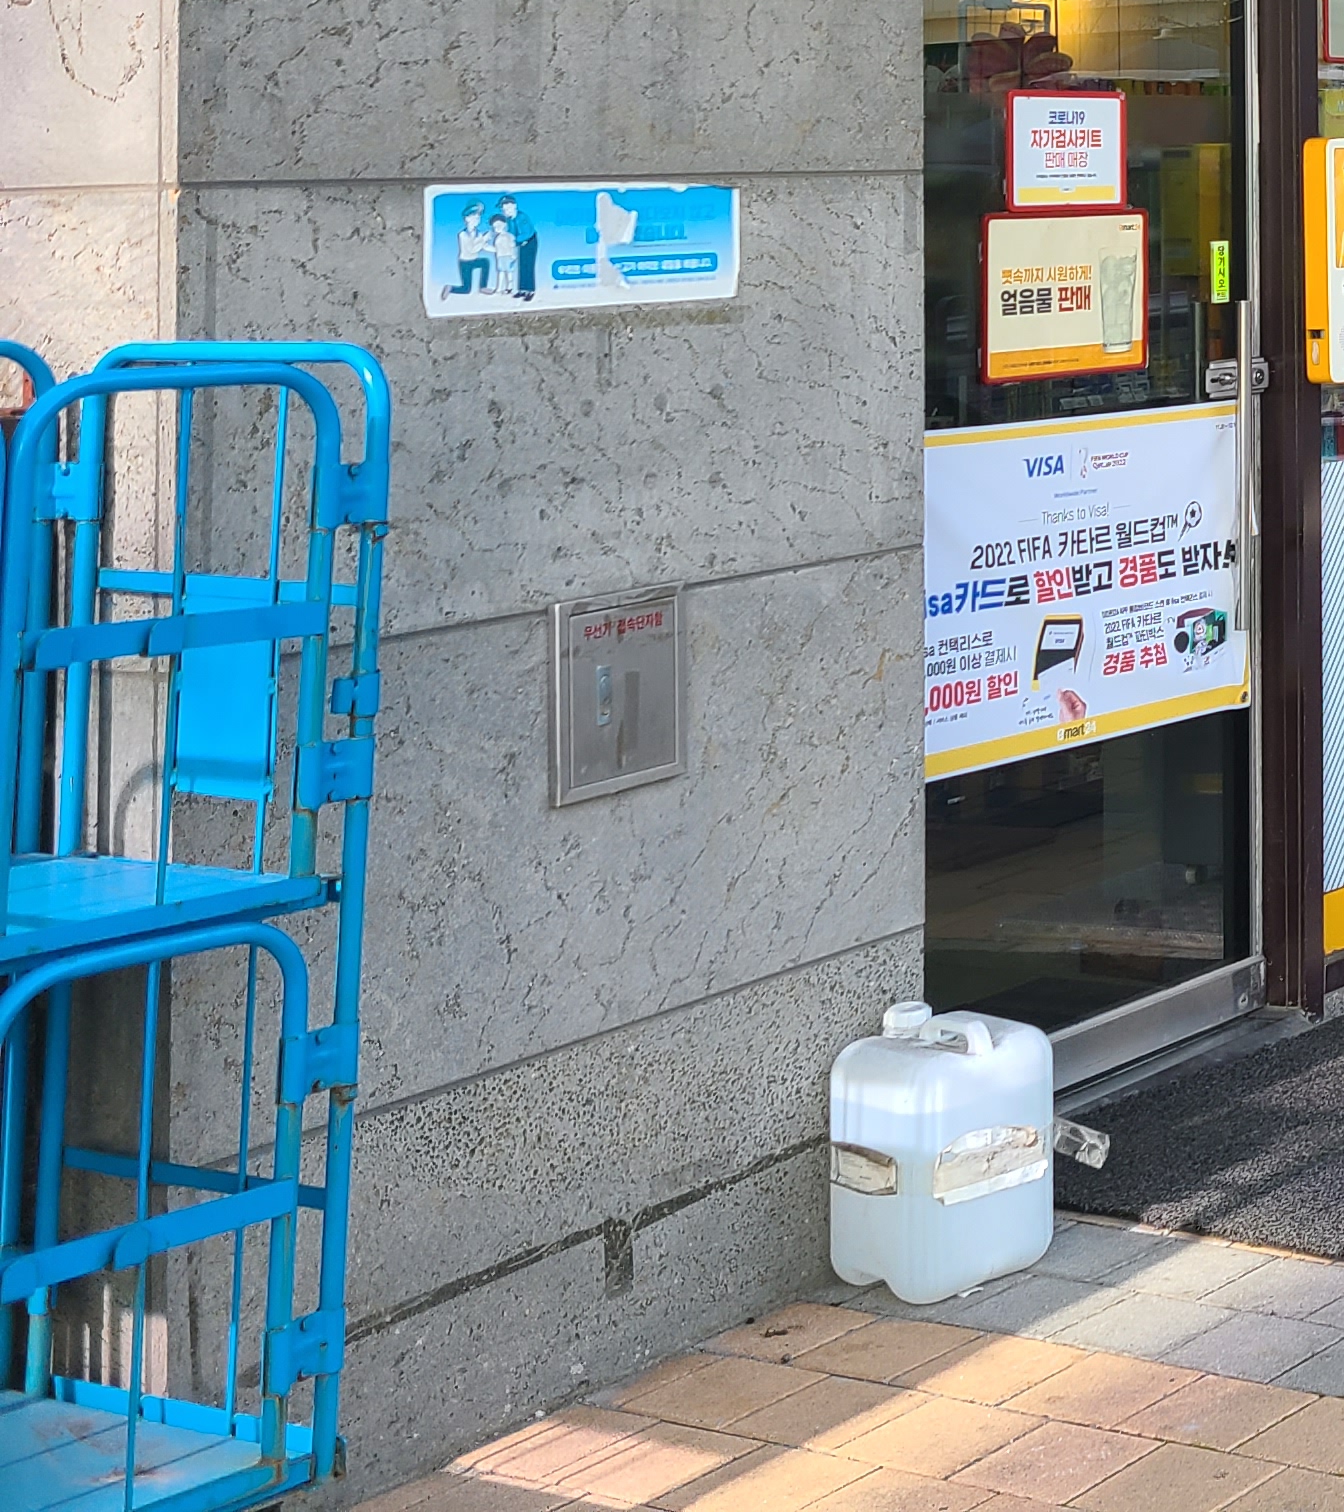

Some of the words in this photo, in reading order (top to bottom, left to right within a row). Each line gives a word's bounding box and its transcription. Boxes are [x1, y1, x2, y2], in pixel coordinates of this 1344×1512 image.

[1048, 111, 1085, 125] 코로나19
[1031, 129, 1102, 148] 자가검사키트
[1045, 152, 1065, 168] 판매
[1068, 151, 1088, 168] 매장
[1046, 265, 1092, 282] 시원하게!
[1217, 245, 1226, 289] 당기시오
[1001, 287, 1053, 316] 얼음물
[1057, 284, 1092, 312] 판매
[1022, 454, 1064, 478] VISA
[1042, 507, 1074, 524] Thanks
[1077, 506, 1086, 519] to
[1088, 502, 1110, 520] Visa!
[970, 541, 1016, 570] 2022
[1017, 534, 1052, 563] FIFA
[1058, 525, 1112, 558] 카타르
[925, 574, 1030, 619] sa카드로
[1033, 560, 1113, 604] 할인받고
[1119, 549, 1177, 588] 경품도
[937, 630, 993, 657] 컨택리스로
[959, 652, 982, 672] 이상
[984, 646, 1017, 668] 결제시
[1103, 650, 1135, 676] 경품
[1140, 643, 1168, 668] 추첨
[986, 670, 1019, 701] 할인
[1057, 720, 1097, 742] emart24
